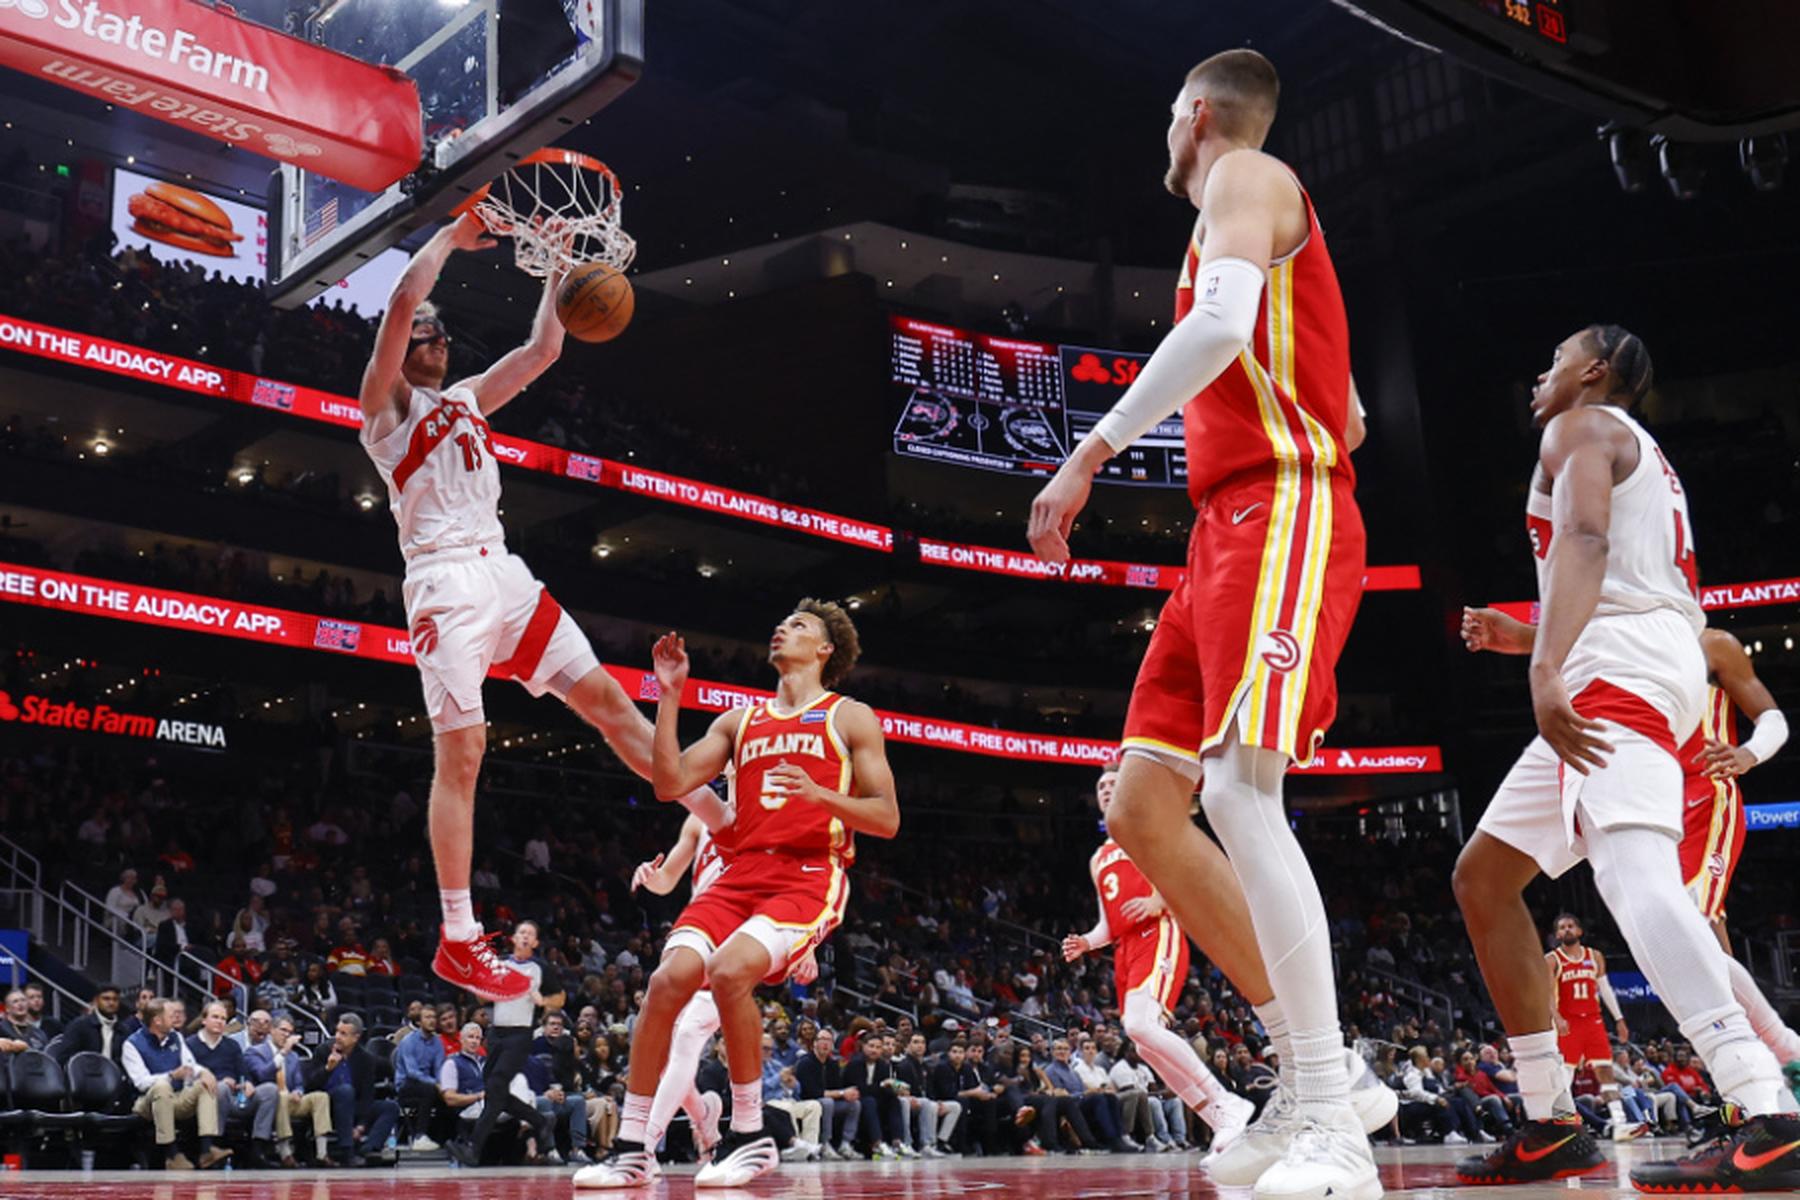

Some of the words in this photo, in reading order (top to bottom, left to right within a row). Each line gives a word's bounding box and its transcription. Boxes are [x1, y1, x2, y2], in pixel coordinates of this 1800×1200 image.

[0, 323, 33, 346] ON
[36, 332, 80, 357] THE
[85, 344, 173, 378] AUDACY
[177, 366, 226, 392] APP.
[492, 441, 527, 463] acy
[622, 470, 676, 496] LISTEN
[678, 483, 699, 502] TO
[701, 490, 779, 520] ATLANTA'S
[780, 508, 811, 528] 92.9
[811, 515, 839, 535] THE
[840, 523, 883, 547] GAME,
[951, 547, 974, 564] ON
[975, 551, 1004, 569] THE
[1007, 557, 1067, 577] AUDACY
[1070, 563, 1107, 580] APP.
[40, 579, 77, 603] ON
[81, 585, 130, 611] THE
[134, 595, 229, 627] AUDACY
[233, 611, 287, 637] APP.
[156, 719, 227, 748] ARENA
[894, 719, 922, 739] THE
[924, 724, 968, 747] GAME,
[970, 732, 1003, 748] FREE
[1005, 736, 1028, 753] ON
[1028, 739, 1058, 757] THE
[1061, 743, 1120, 762] AUDACY
[741, 733, 826, 768] ATLANTA
[1358, 755, 1428, 769] Audacy
[760, 769, 788, 810] 5
[1751, 809, 1800, 825] Power
[1103, 872, 1119, 901] 3
[1573, 982, 1588, 999] 11
